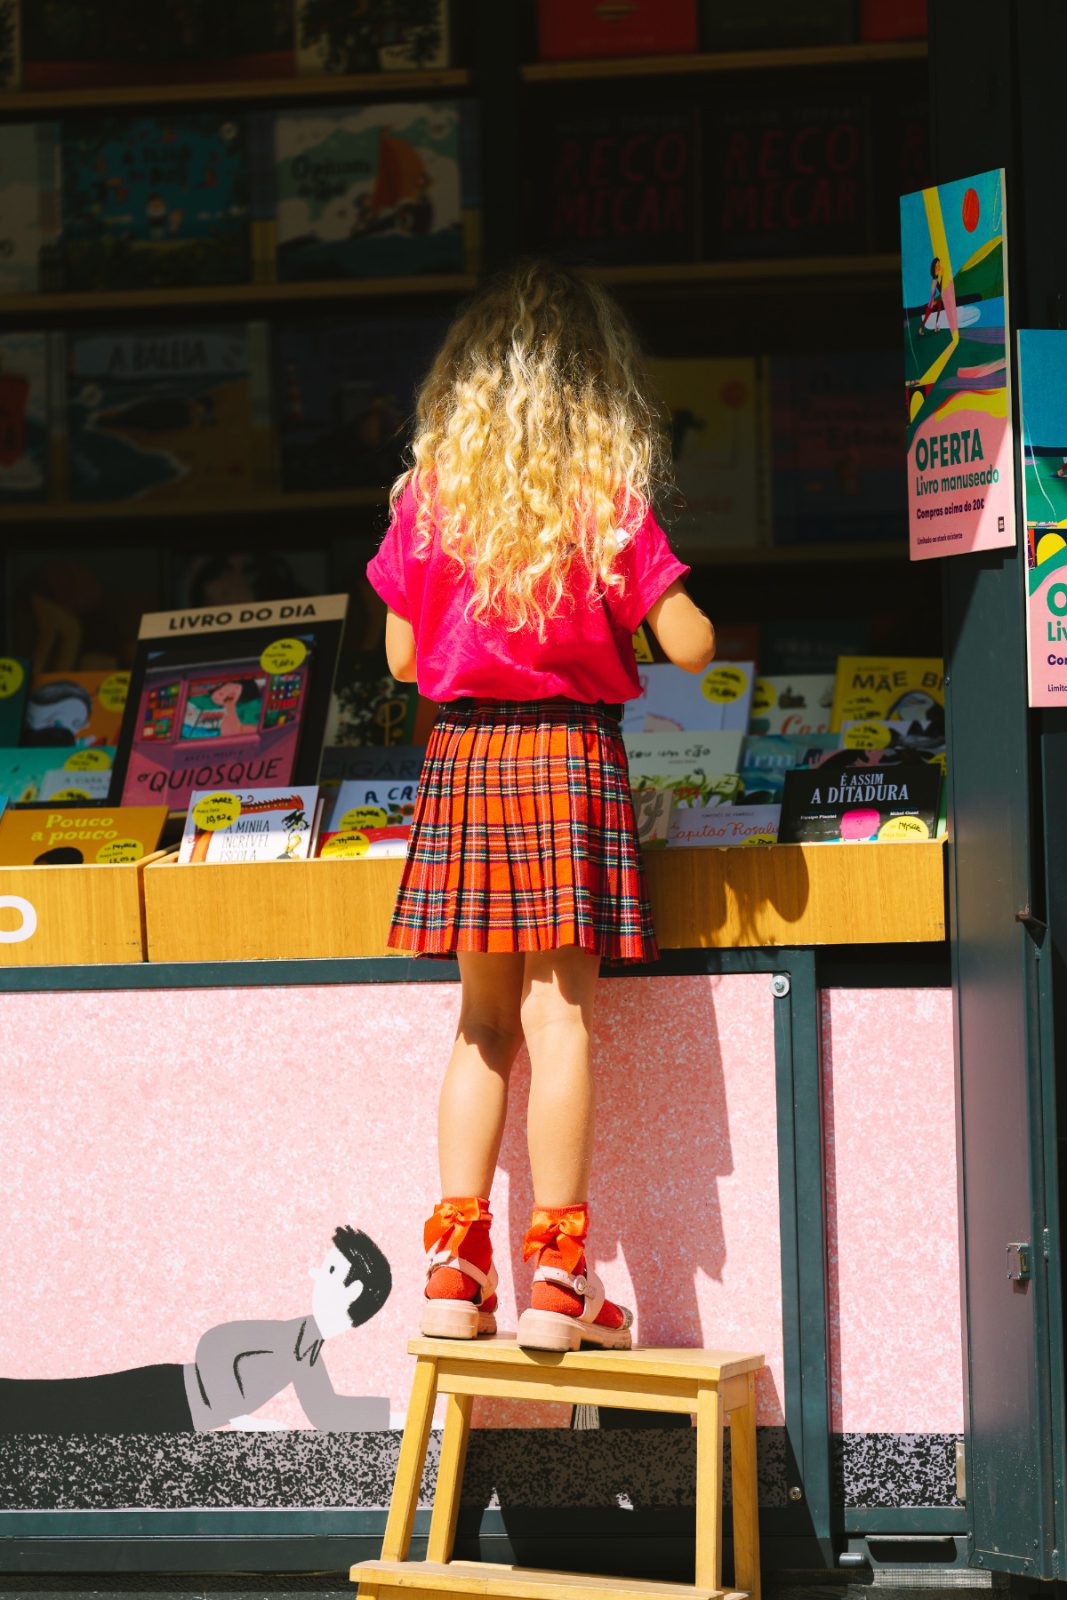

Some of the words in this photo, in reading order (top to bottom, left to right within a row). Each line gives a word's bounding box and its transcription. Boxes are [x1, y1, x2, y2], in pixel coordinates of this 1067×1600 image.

[915, 428, 984, 472] OFERTA
[916, 475, 938, 496] Livro
[941, 464, 999, 492] manuseado
[917, 508, 943, 520] Compras
[944, 503, 963, 514] acima
[964, 502, 971, 512] de
[168, 612, 233, 631] LIVRO
[239, 608, 273, 623] DO
[279, 603, 317, 619] DIA
[150, 758, 281, 792] QUIOSQUE
[840, 773, 847, 787] É
[850, 773, 884, 786] ASSIM
[364, 790, 379, 805] A
[388, 785, 419, 801] CA
[810, 788, 821, 805] A
[827, 784, 910, 804] DITADURA
[45, 814, 114, 828] Pouco
[235, 819, 270, 834] MINHA
[31, 830, 43, 842] a
[48, 829, 118, 845] pouco
